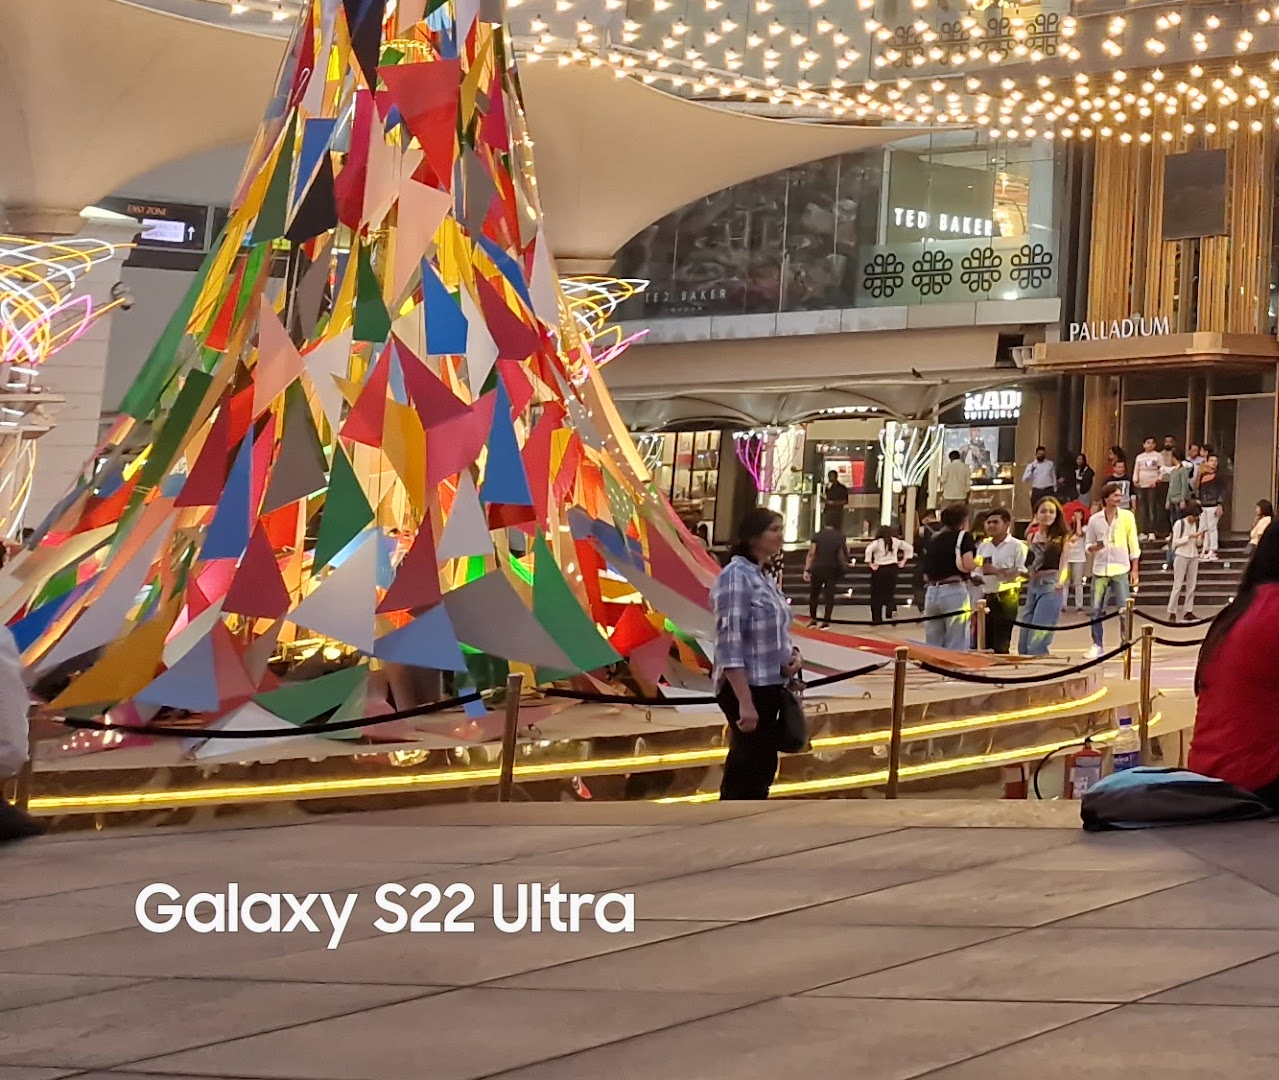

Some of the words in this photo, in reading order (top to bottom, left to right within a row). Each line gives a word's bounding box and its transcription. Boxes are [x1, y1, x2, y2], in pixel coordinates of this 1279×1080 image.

[894, 207, 927, 229] TED
[939, 213, 993, 237] BAKER
[681, 288, 727, 301] BAKER
[1069, 312, 1170, 342] PALLADIUM
